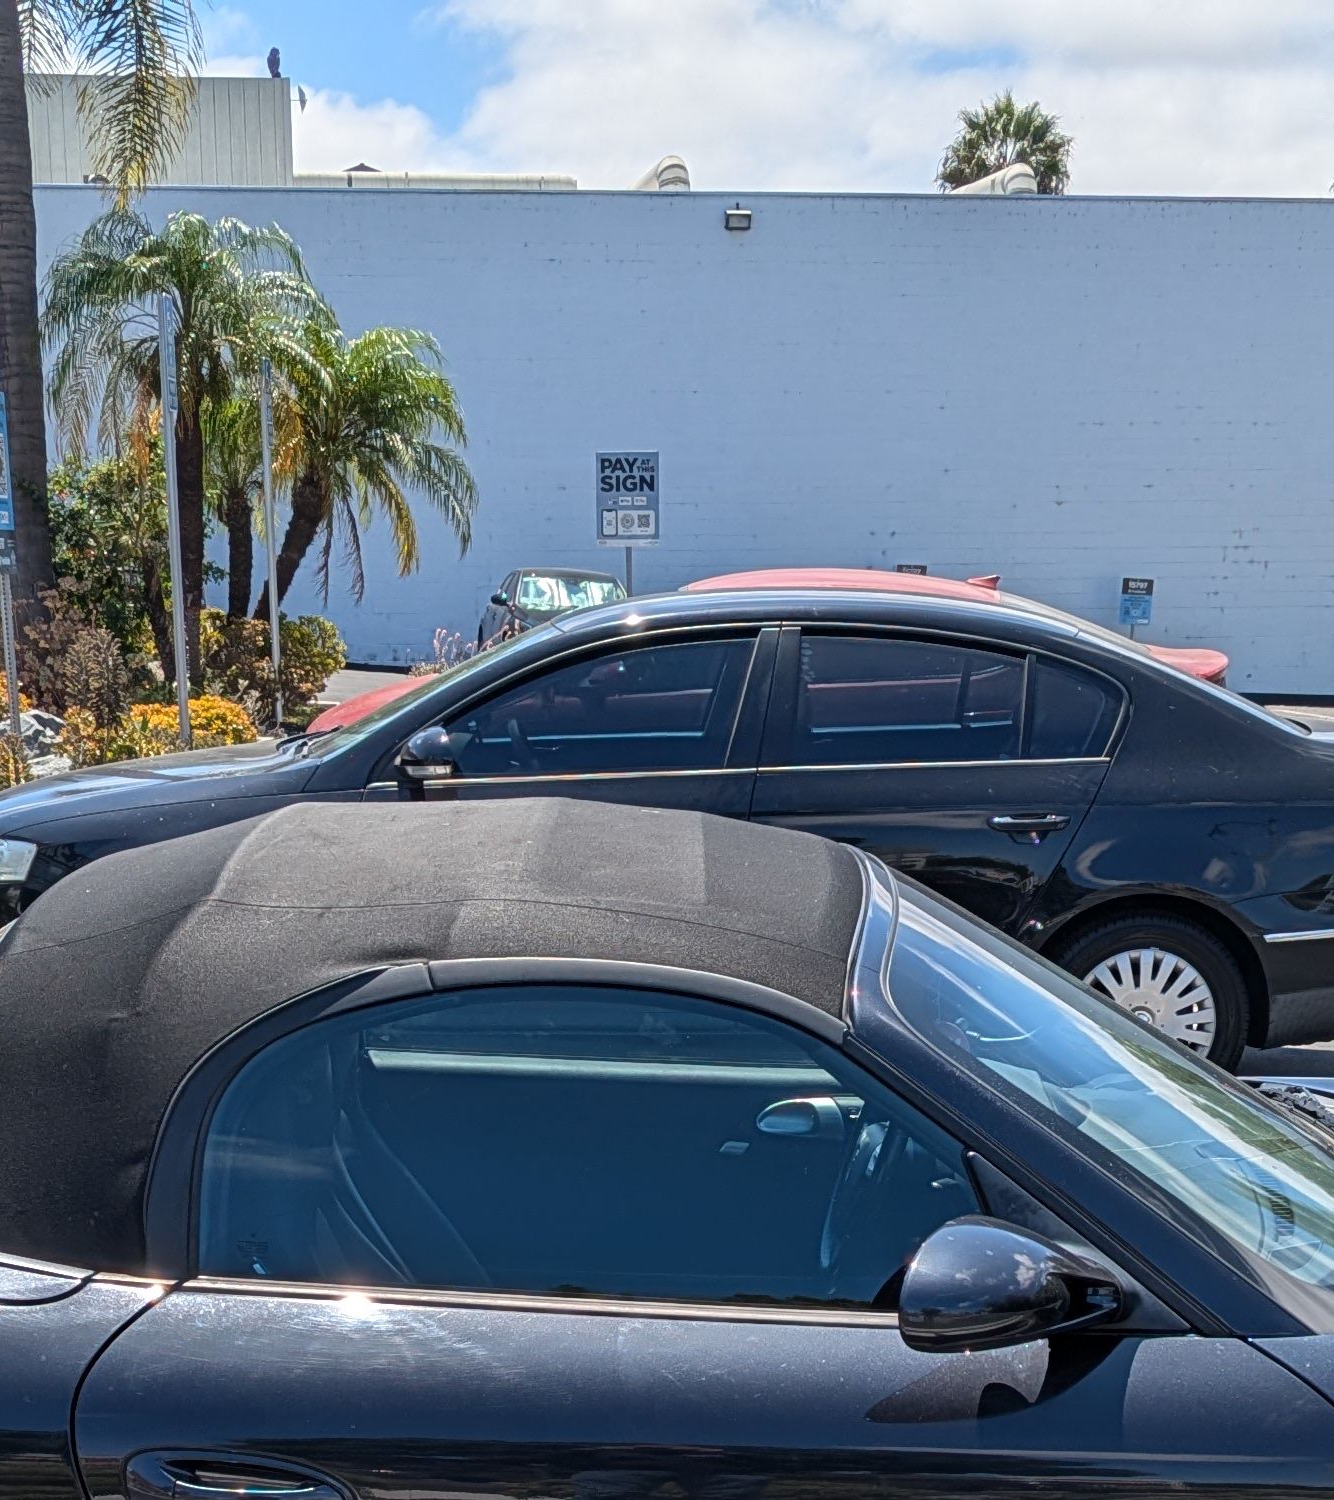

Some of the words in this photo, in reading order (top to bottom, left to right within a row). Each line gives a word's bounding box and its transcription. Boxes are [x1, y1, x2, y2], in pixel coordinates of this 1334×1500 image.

[600, 457, 638, 474] PAY
[636, 465, 655, 473] THIS
[600, 474, 655, 492] SIGN
